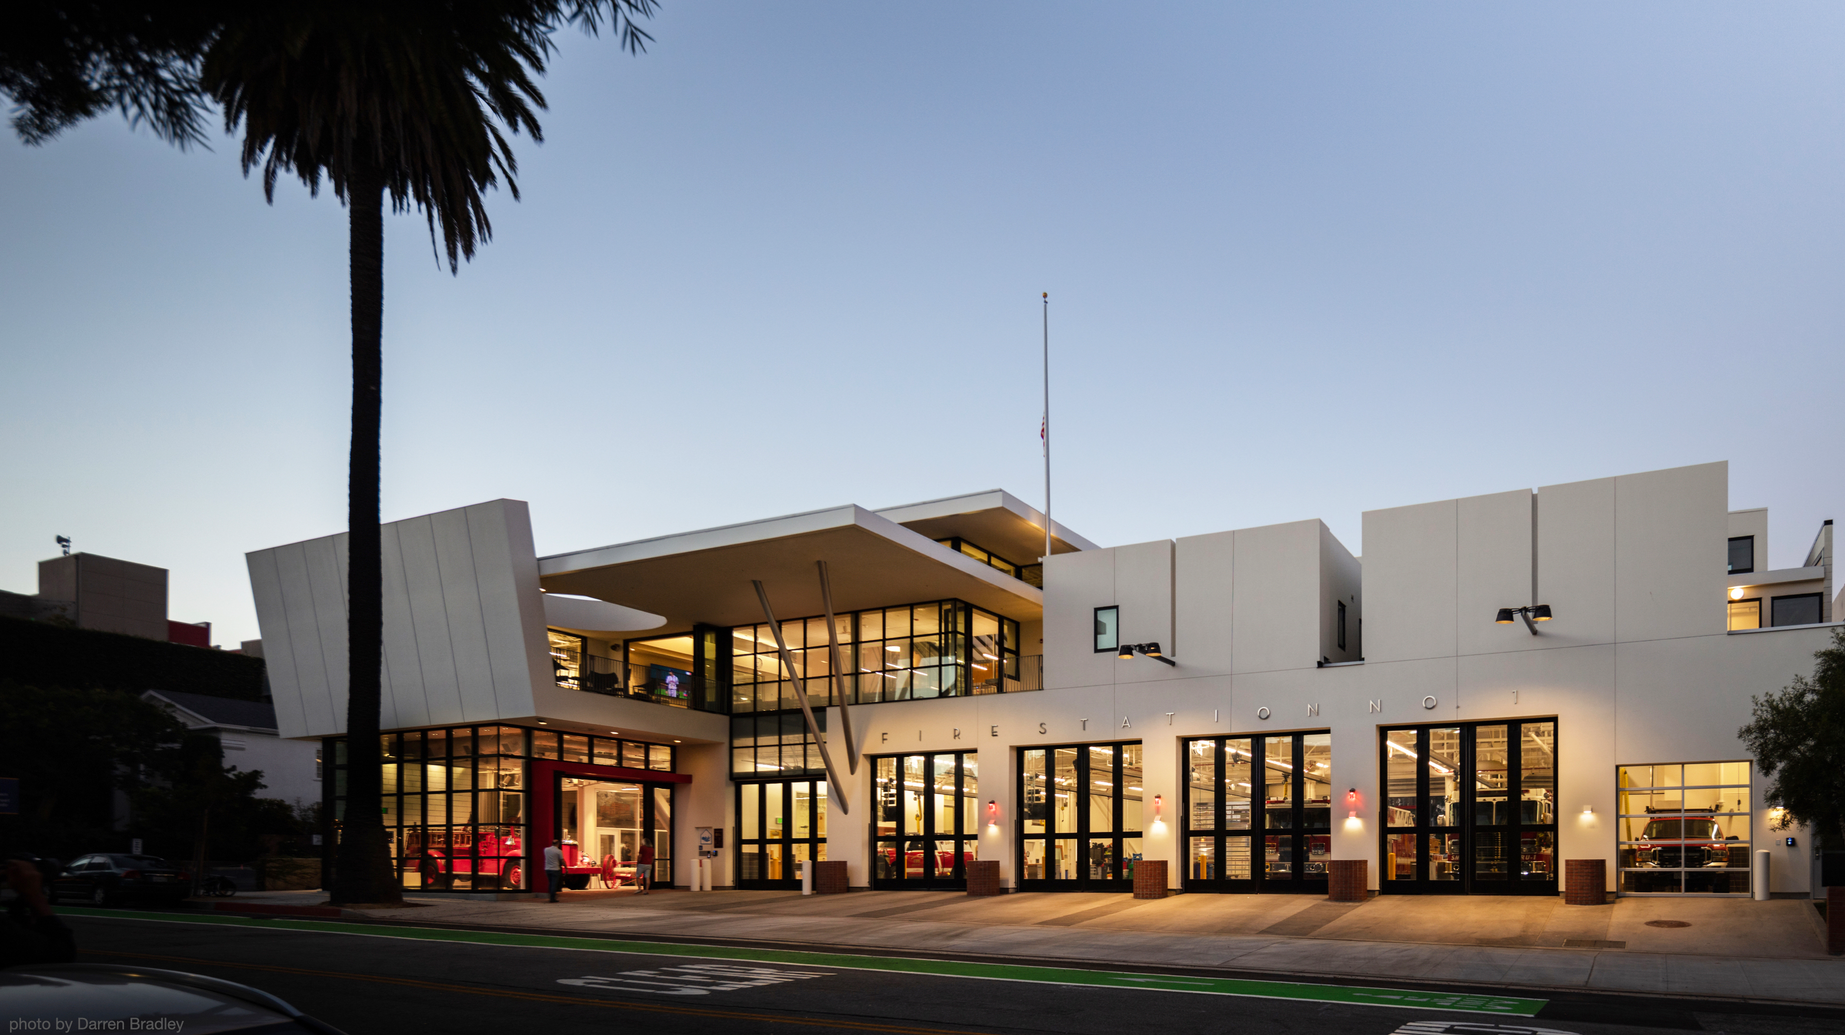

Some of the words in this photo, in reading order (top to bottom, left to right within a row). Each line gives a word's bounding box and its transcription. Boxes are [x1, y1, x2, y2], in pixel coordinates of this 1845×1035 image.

[881, 724, 999, 745] FIRE
[1038, 702, 1320, 735] STATION
[1512, 689, 1519, 705] 1
[556, 964, 838, 996] CLEAR
